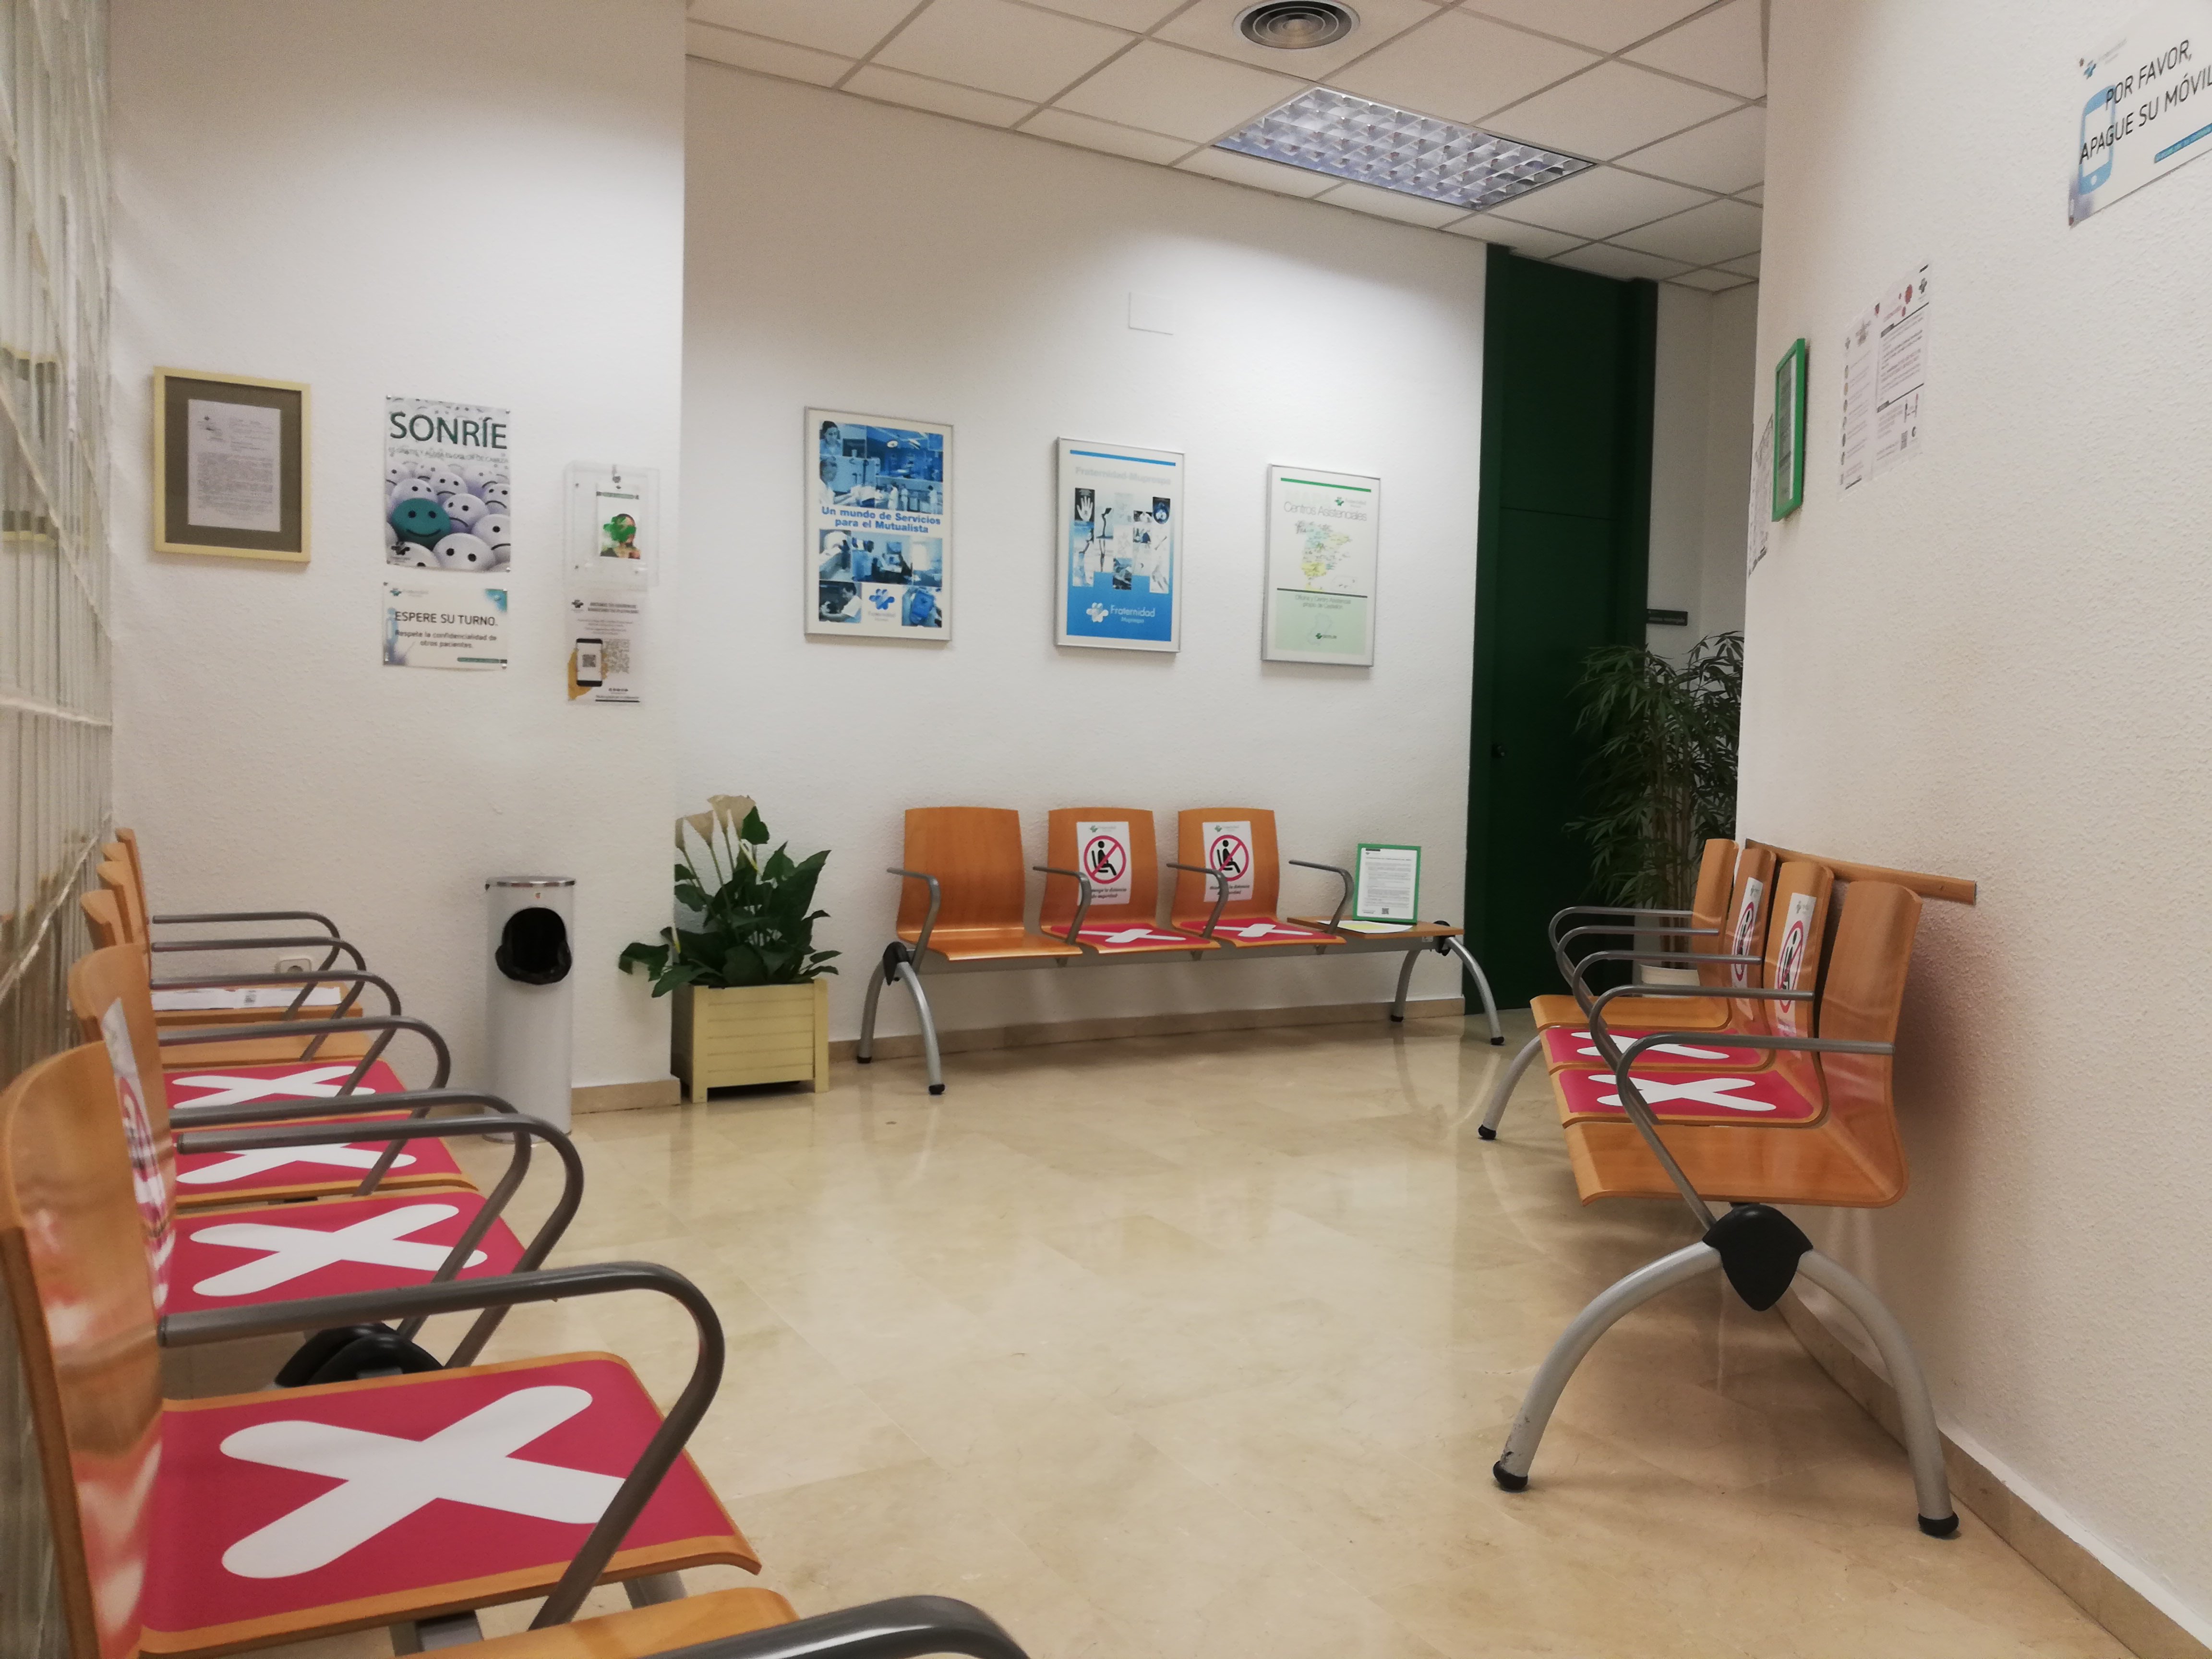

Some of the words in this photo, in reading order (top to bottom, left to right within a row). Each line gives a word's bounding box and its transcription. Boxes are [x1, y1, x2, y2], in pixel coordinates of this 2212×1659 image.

[2105, 75, 2133, 111] POR
[2138, 39, 2192, 90] FAVOR,
[2079, 111, 2134, 165] APAGUE
[2139, 96, 2159, 127] SU
[2164, 65, 2212, 112] MÓVIL
[390, 411, 507, 449] SONRÍE
[821, 506, 836, 515] Un
[840, 510, 876, 519] mundo
[879, 512, 892, 520] de
[895, 513, 941, 525] Servicios
[1284, 501, 1316, 515] Centros
[1318, 505, 1367, 521] Asistenciales
[835, 518, 858, 528] para
[863, 520, 871, 529] el
[875, 521, 929, 533] Mutualista
[395, 611, 437, 623] ESPERE
[441, 614, 455, 624] SU
[457, 615, 498, 626] TURNO.
[1110, 604, 1155, 617] Fraternidad
